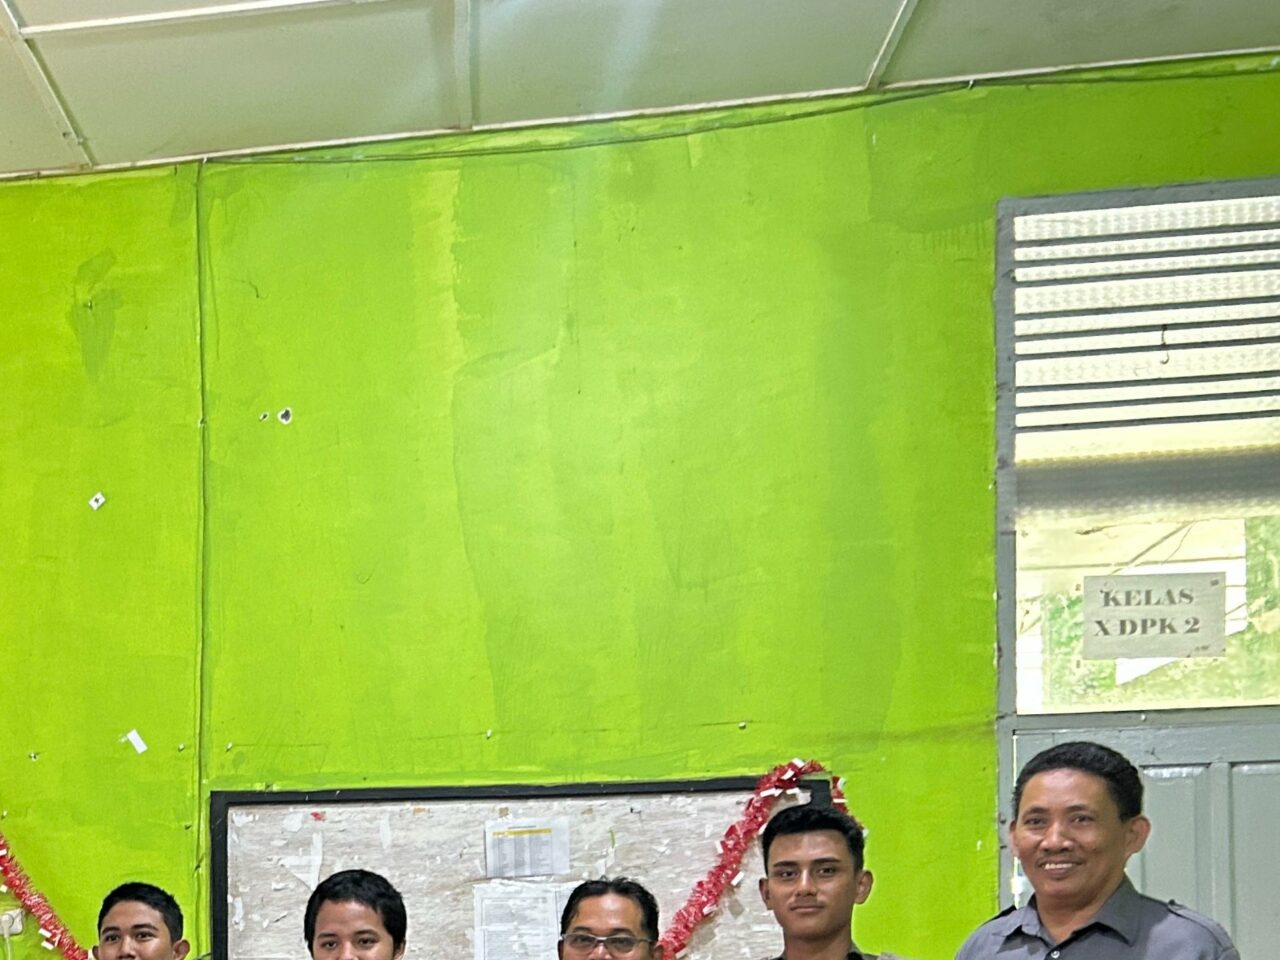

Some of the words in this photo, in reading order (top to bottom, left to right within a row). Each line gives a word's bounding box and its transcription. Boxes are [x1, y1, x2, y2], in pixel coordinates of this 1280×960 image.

[1100, 589, 1194, 607] KELAS
[1094, 619, 1111, 636] X
[1119, 617, 1178, 635] DPK
[1184, 616, 1200, 634] 2
